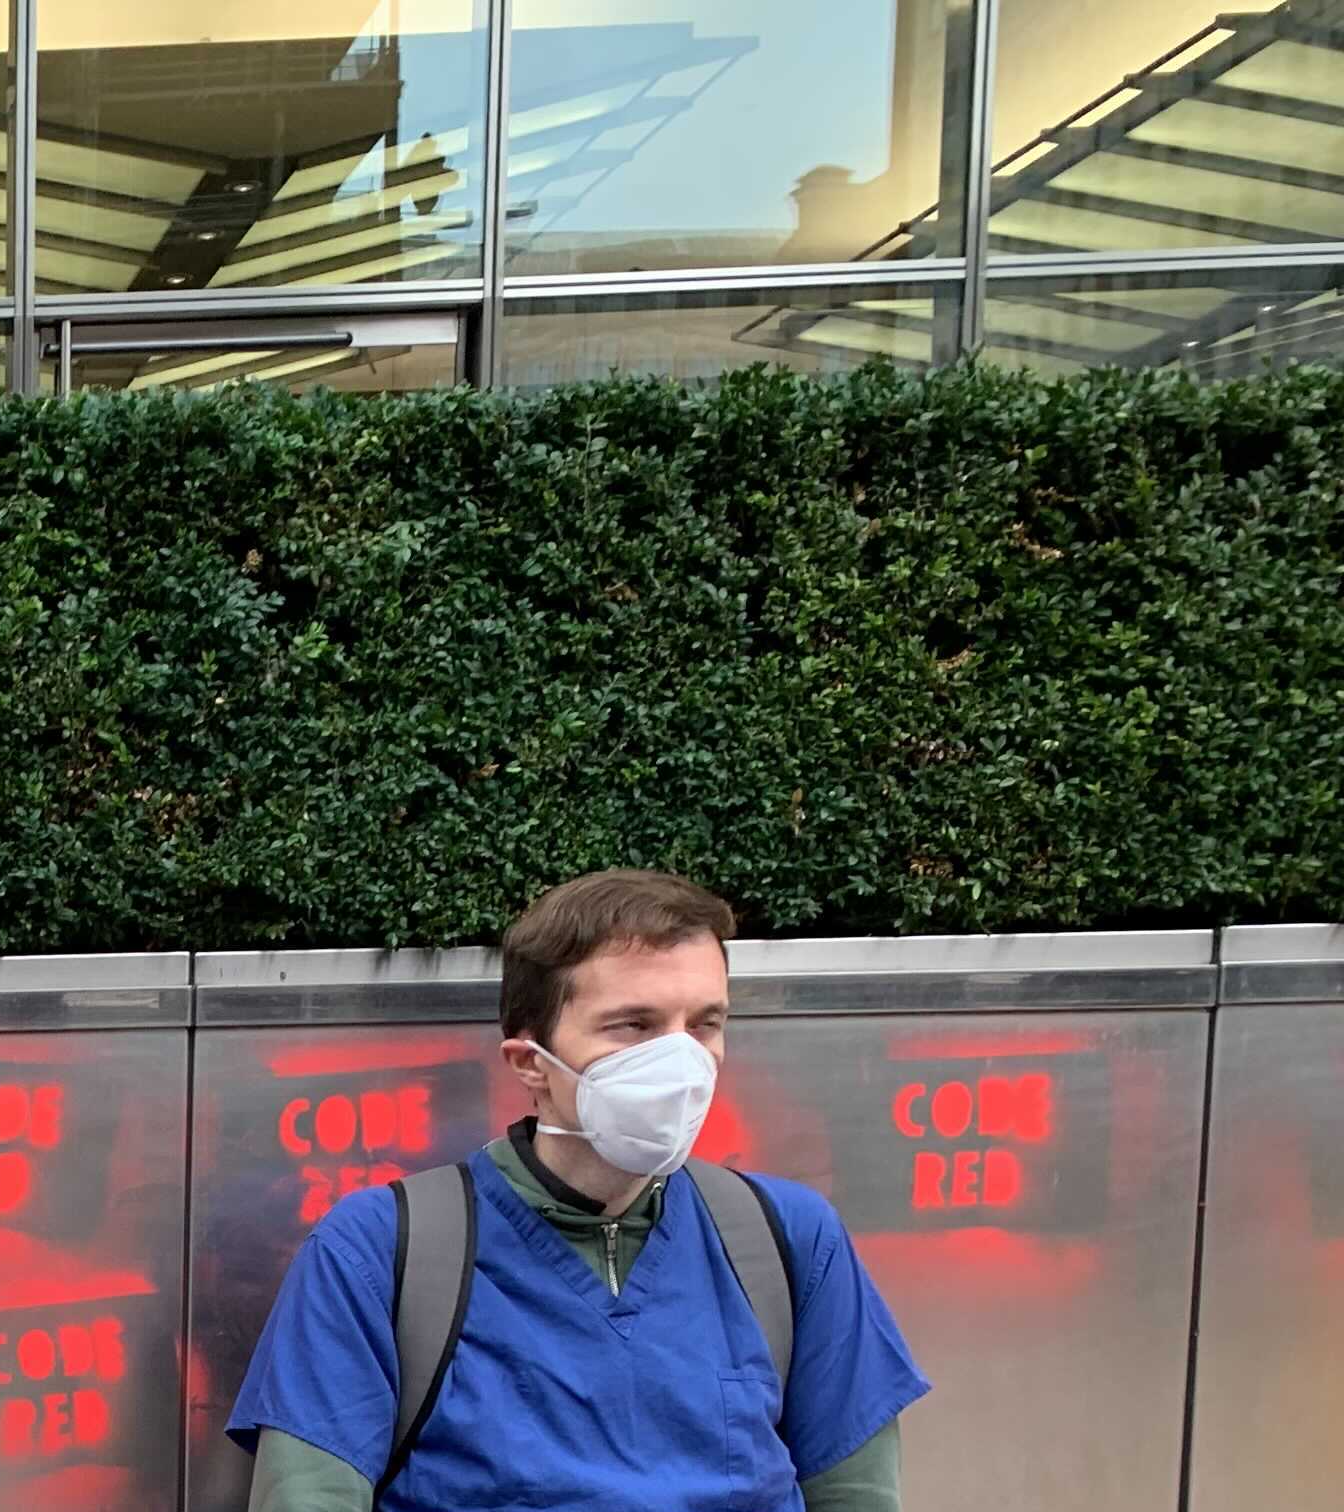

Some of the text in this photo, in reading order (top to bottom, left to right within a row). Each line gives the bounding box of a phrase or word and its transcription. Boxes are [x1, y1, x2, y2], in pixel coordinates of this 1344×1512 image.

[278, 1084, 431, 1155] CODE
[893, 1073, 1051, 1140] CODE
[913, 1150, 1021, 1209] RED
[0, 1388, 109, 1456] RED
